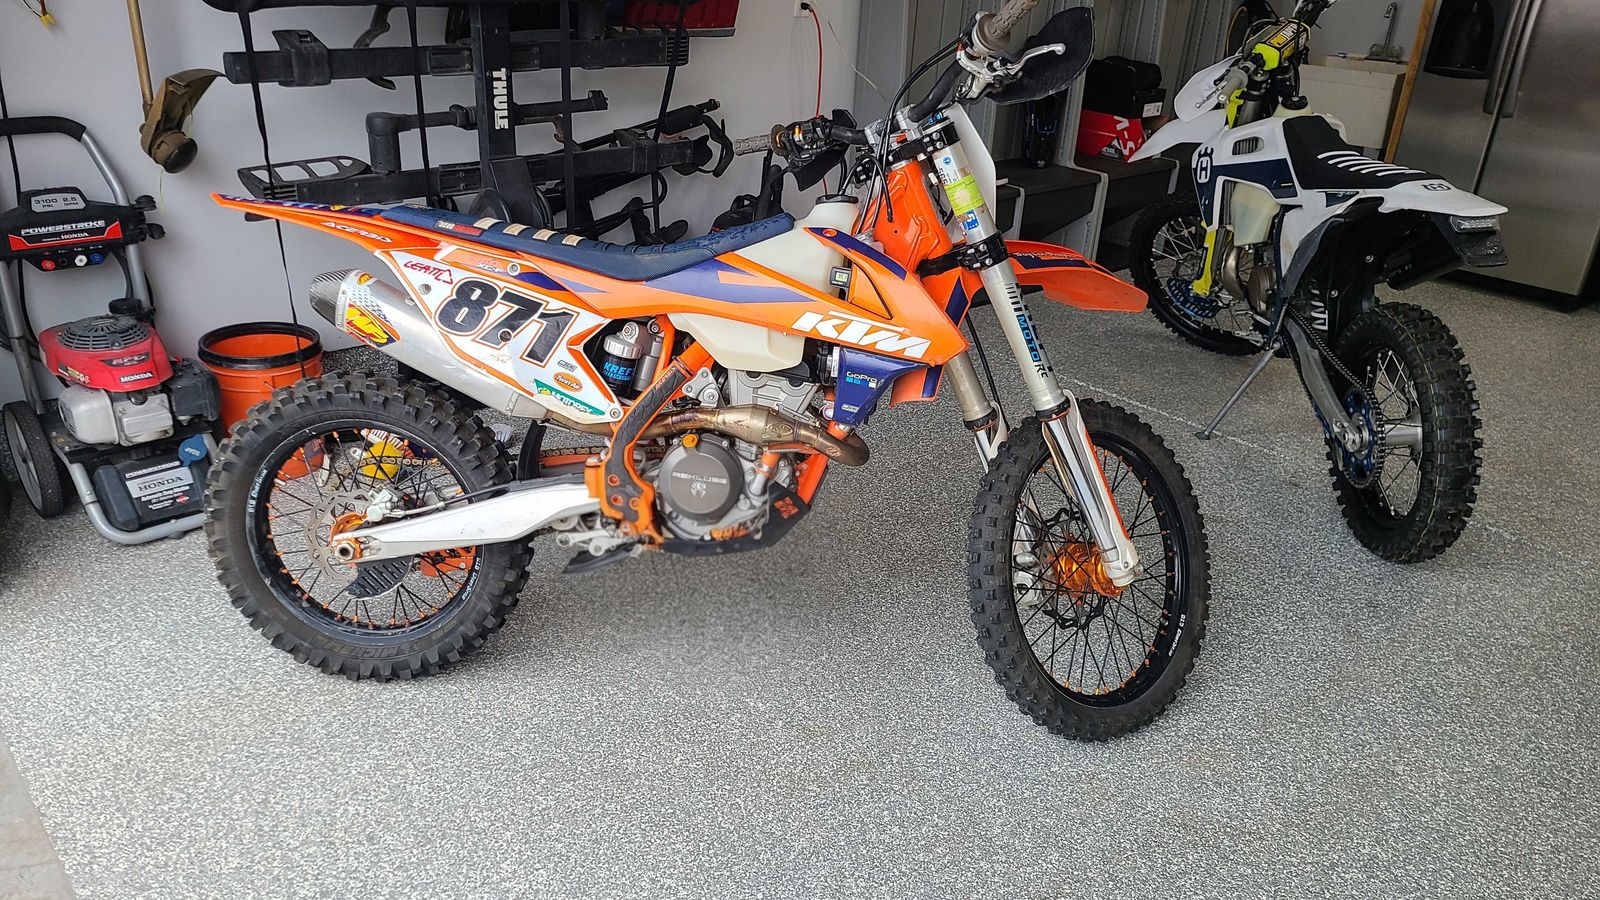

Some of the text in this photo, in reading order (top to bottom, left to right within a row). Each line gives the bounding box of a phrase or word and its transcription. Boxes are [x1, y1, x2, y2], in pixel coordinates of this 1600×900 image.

[492, 67, 509, 130] THULE
[21, 220, 106, 236] POWERSTROKE
[61, 232, 89, 240] HONDA
[433, 278, 577, 367] 871
[791, 310, 932, 359] KTM
[1017, 315, 1042, 362] MOTO
[604, 362, 635, 376] KREF
[846, 371, 878, 383] GoPro
[120, 372, 154, 383] HONDA
[137, 476, 184, 492] HONDA
[671, 471, 728, 485] REKLUSE
